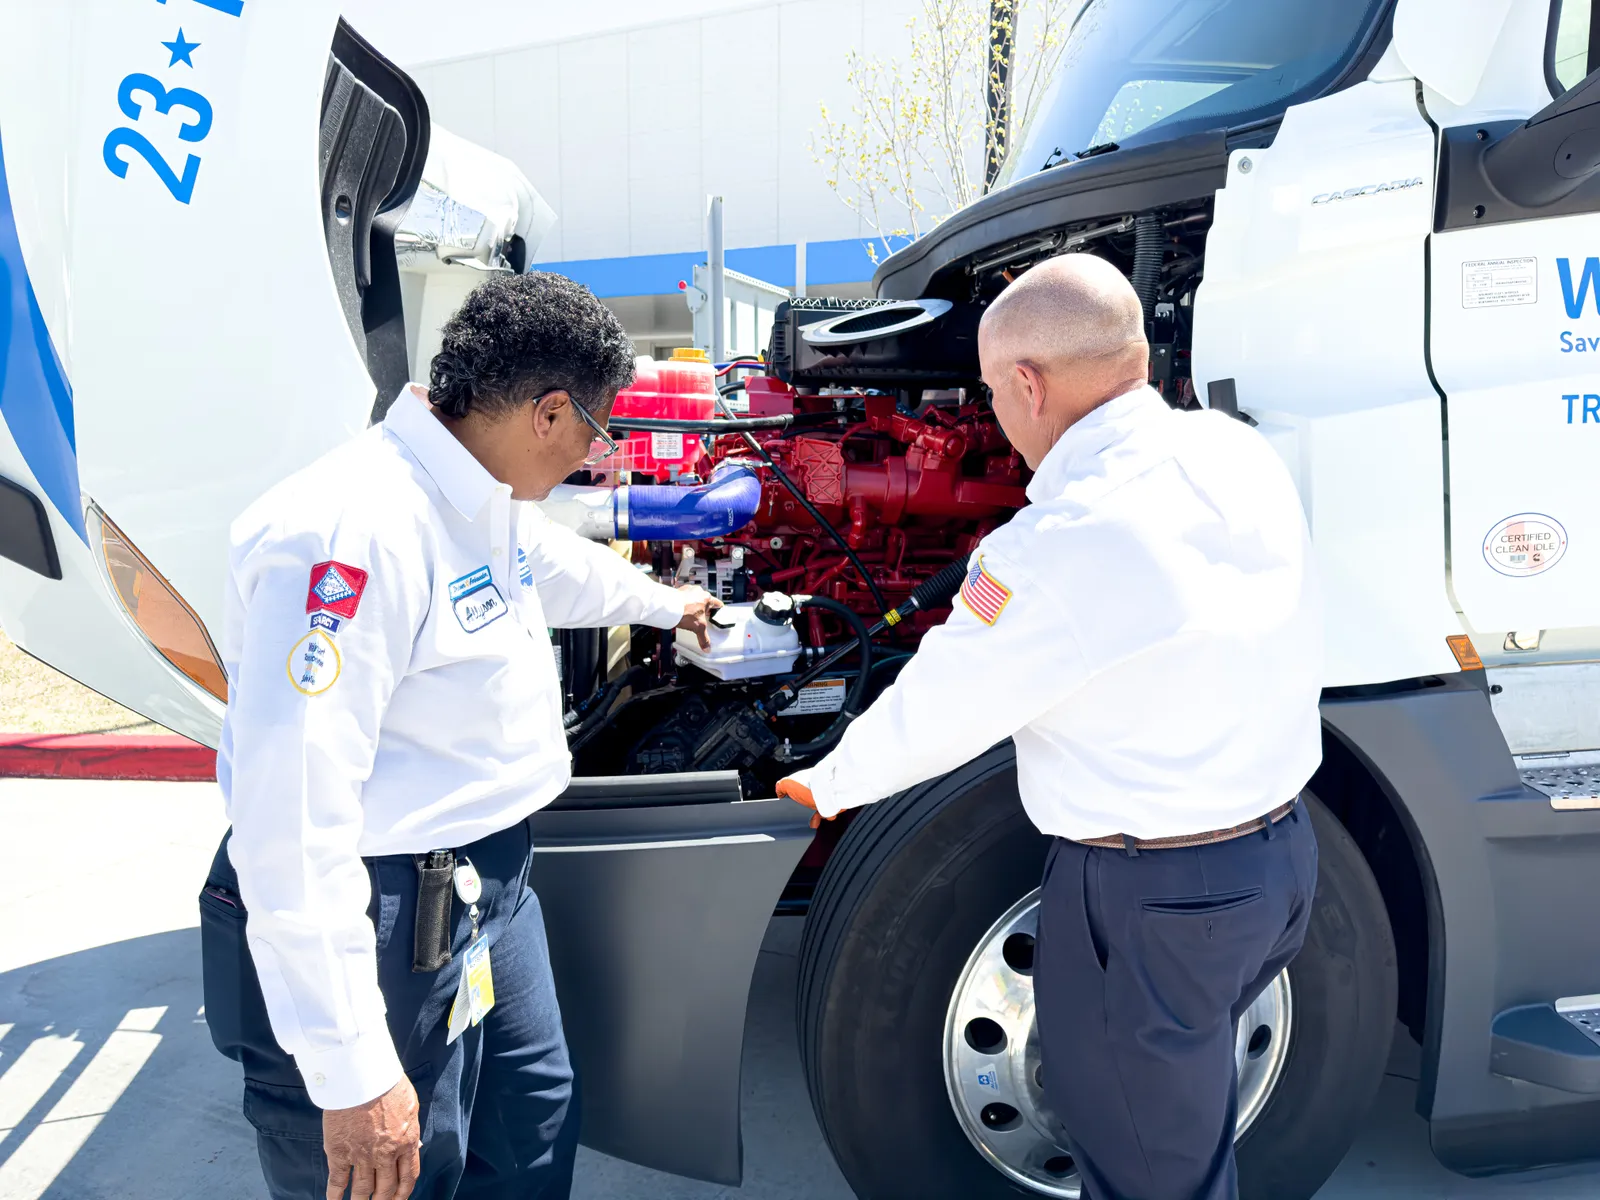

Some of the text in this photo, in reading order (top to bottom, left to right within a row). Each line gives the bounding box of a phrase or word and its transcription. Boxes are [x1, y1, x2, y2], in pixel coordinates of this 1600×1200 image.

[103, 72, 213, 205] 23
[1311, 178, 1423, 204] CASCADIA
[1562, 394, 1600, 424] TR
[1495, 543, 1556, 554] CLEAN IDLE
[1500, 532, 1552, 543] CERTIFIED
